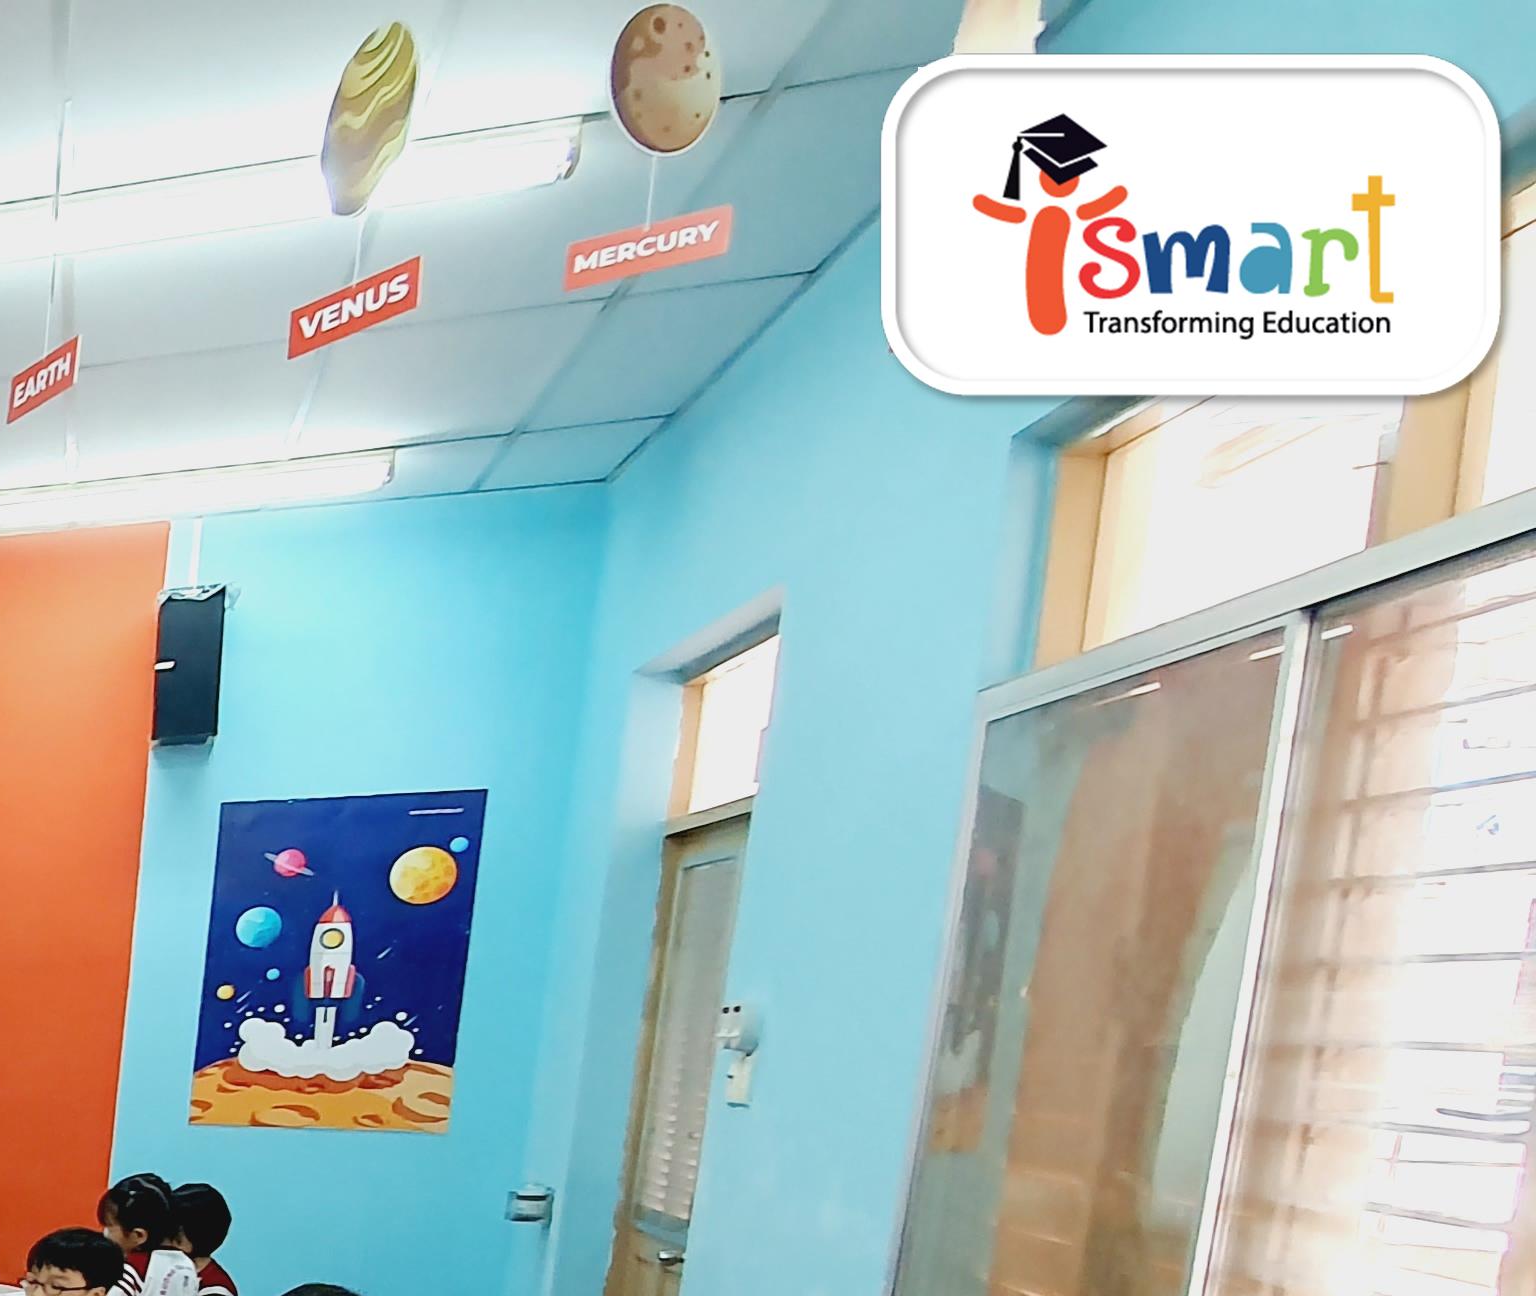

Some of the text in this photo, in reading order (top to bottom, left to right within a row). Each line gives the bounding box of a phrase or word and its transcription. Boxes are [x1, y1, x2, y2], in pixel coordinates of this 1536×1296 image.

[572, 219, 720, 274] MERCURY
[298, 272, 410, 339] VENUS
[13, 352, 72, 409] EARTH
